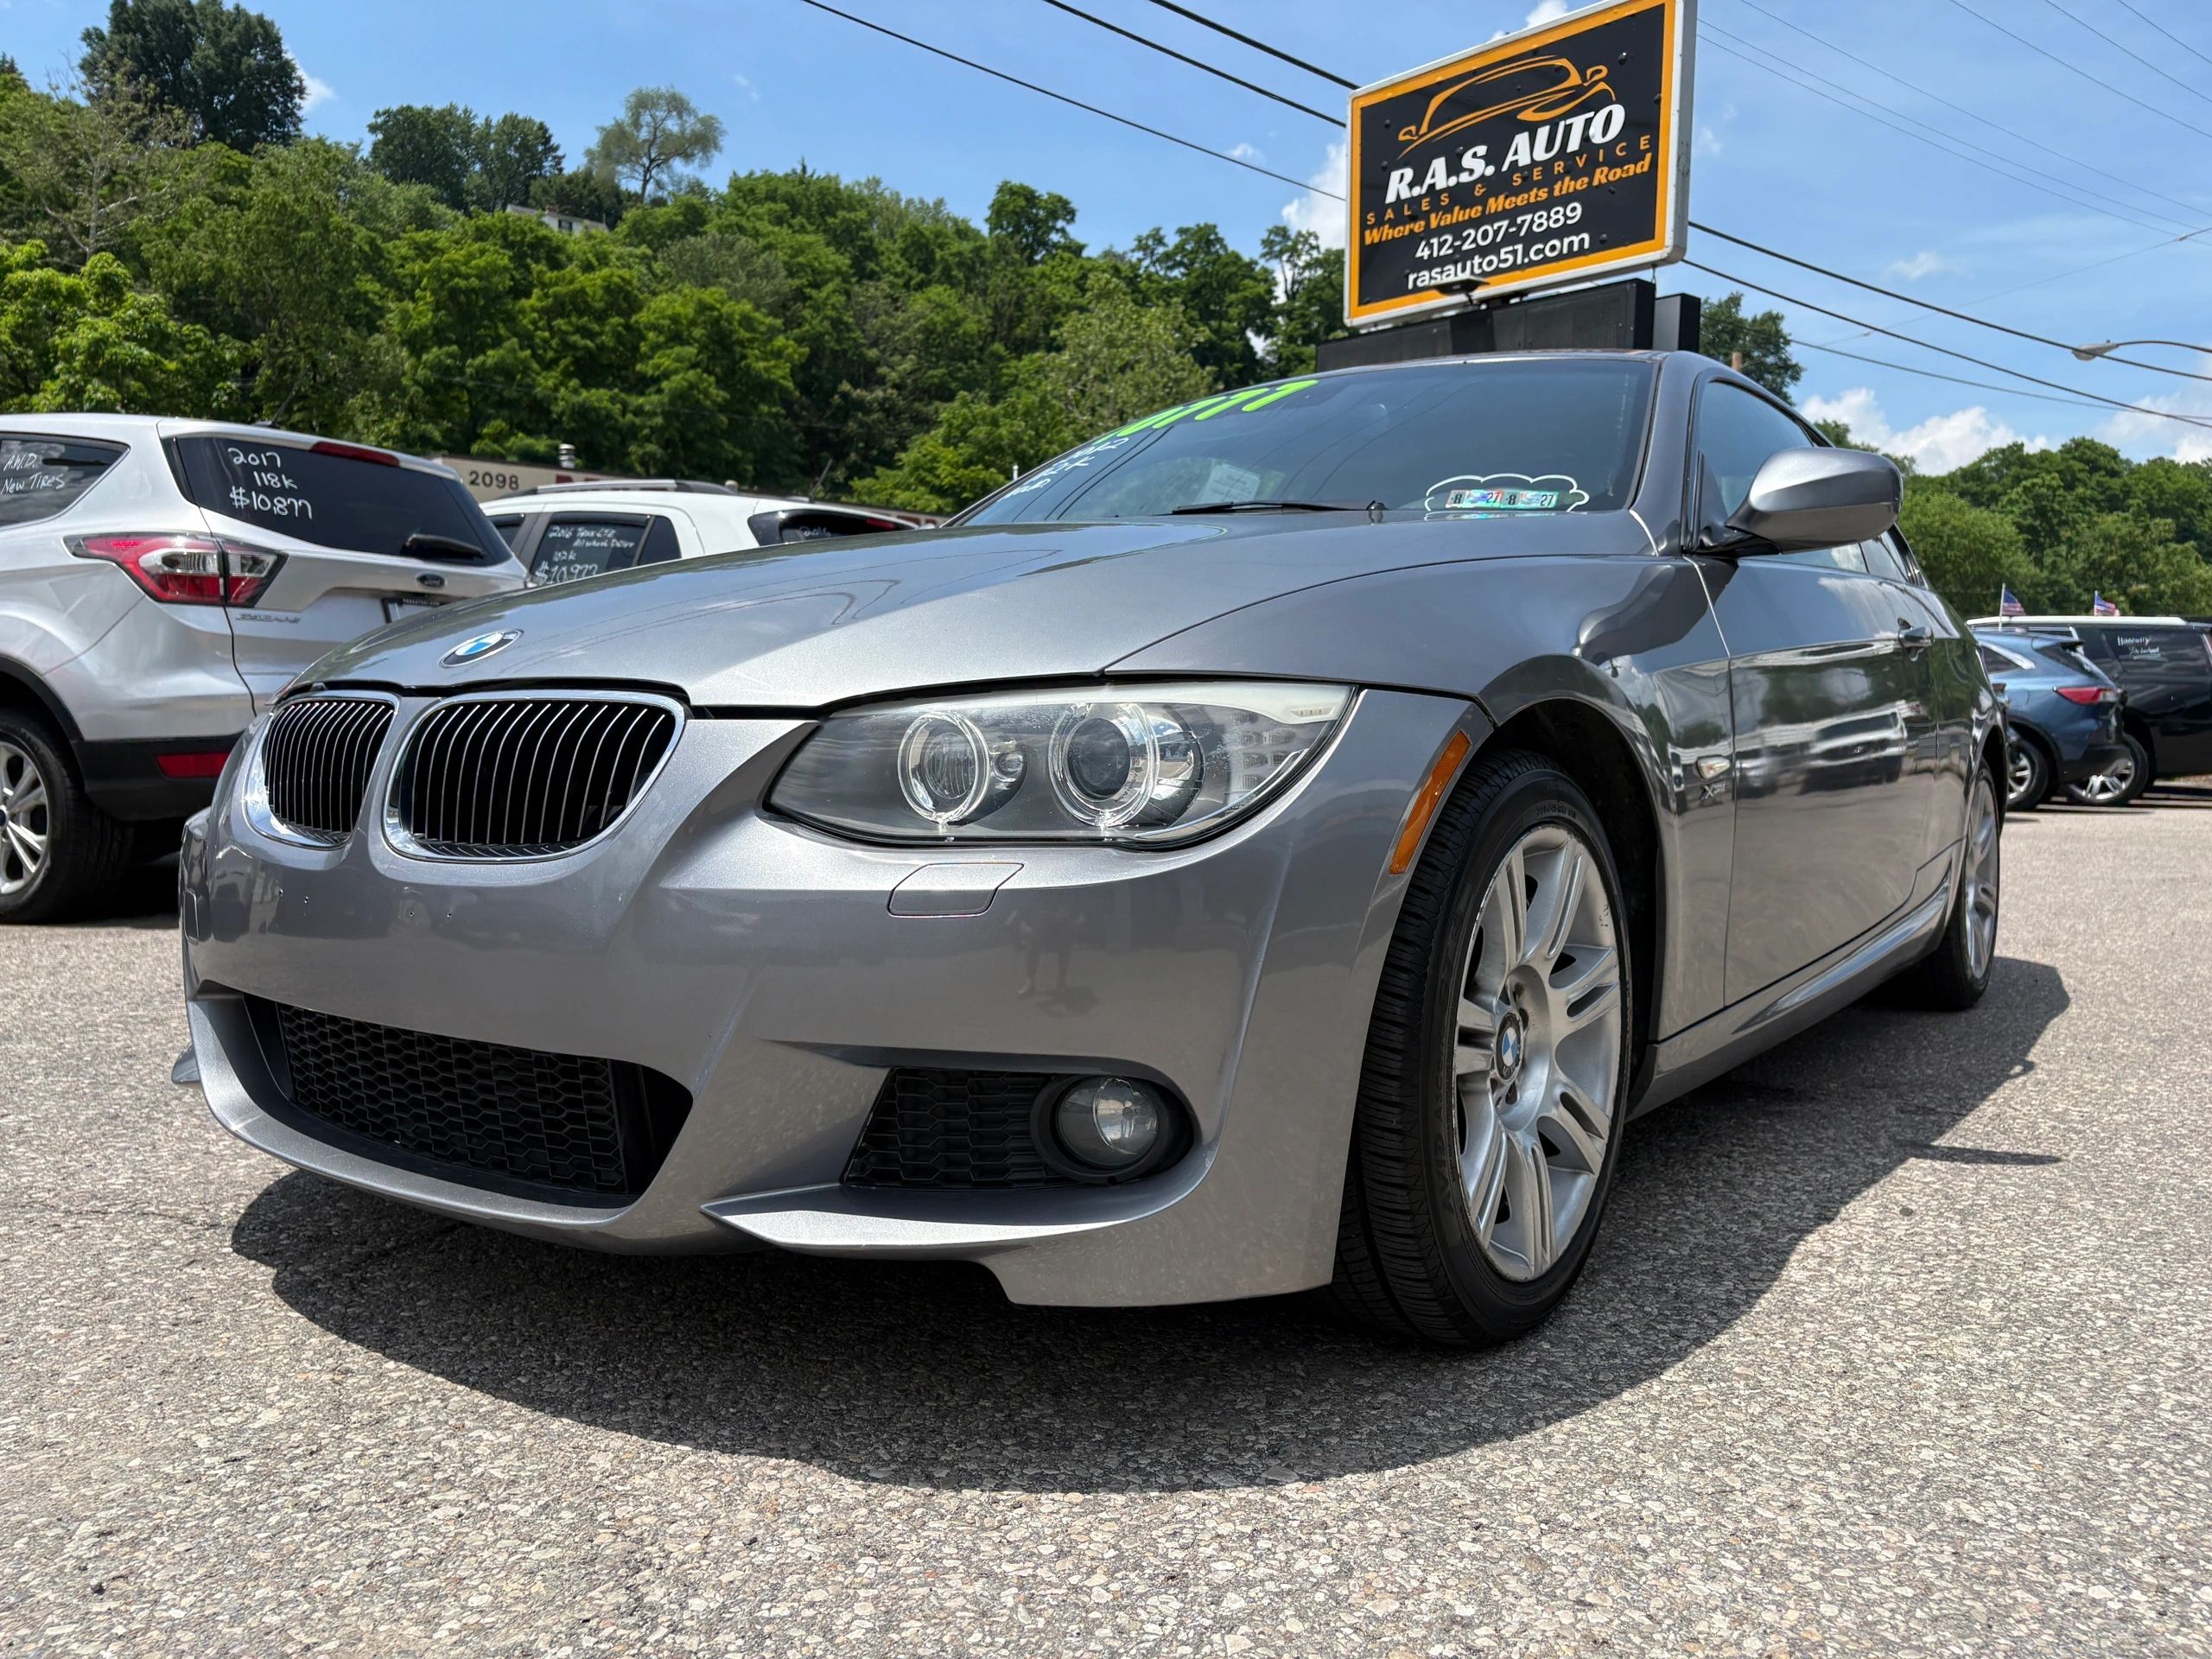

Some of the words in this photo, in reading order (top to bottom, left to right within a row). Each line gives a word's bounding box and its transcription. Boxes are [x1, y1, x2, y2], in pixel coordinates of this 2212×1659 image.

[1384, 144, 1496, 205] R.A.S.
[1501, 104, 1626, 172] AUTO
[1363, 219, 1425, 245] Where
[1428, 205, 1482, 230] Value
[1485, 186, 1549, 215] Meets
[1553, 175, 1590, 197] the
[1592, 152, 1653, 187] Road
[1366, 193, 1450, 226] SALES
[1474, 183, 1487, 198] &
[1512, 135, 1651, 187] SERVICE
[1414, 202, 1583, 260] 412-207-7889
[1407, 231, 1591, 290] rasauto51.com
[227, 448, 282, 467] 2017
[469, 471, 519, 490] 2098
[1, 478, 25, 494] New
[229, 486, 312, 520] $10,877
[1486, 493, 1500, 504] 27
[1540, 494, 1554, 506] 27
